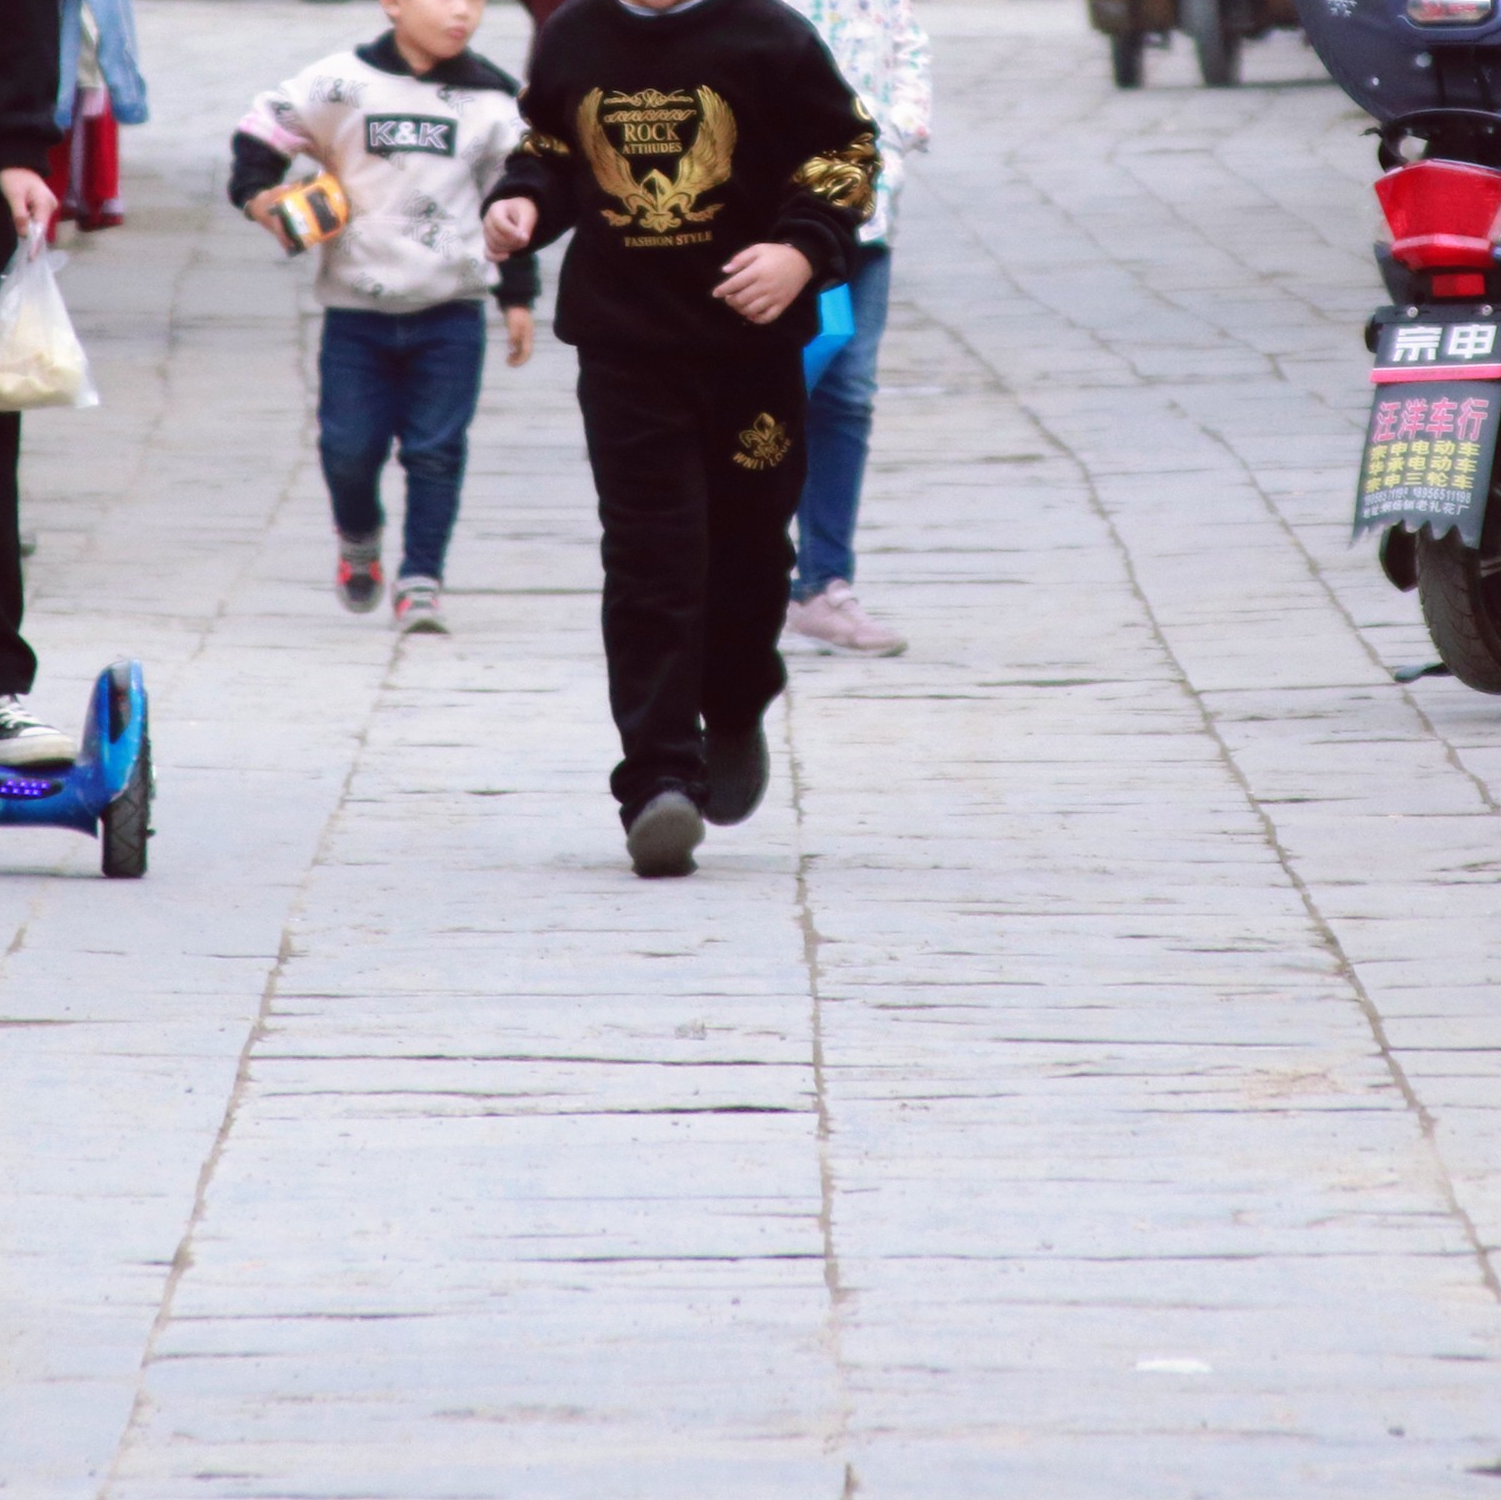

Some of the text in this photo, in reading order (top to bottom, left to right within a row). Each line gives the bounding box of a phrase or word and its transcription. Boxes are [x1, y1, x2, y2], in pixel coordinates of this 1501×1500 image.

[369, 120, 449, 151] K&K
[623, 122, 680, 142] ROCK
[624, 231, 713, 248] FASHION STYLE
[1393, 324, 1497, 362] 宗申
[1372, 397, 1490, 443] 汪洋车行
[1369, 440, 1481, 462] 宗申电动车
[1364, 472, 1475, 494] 宗申三轮车
